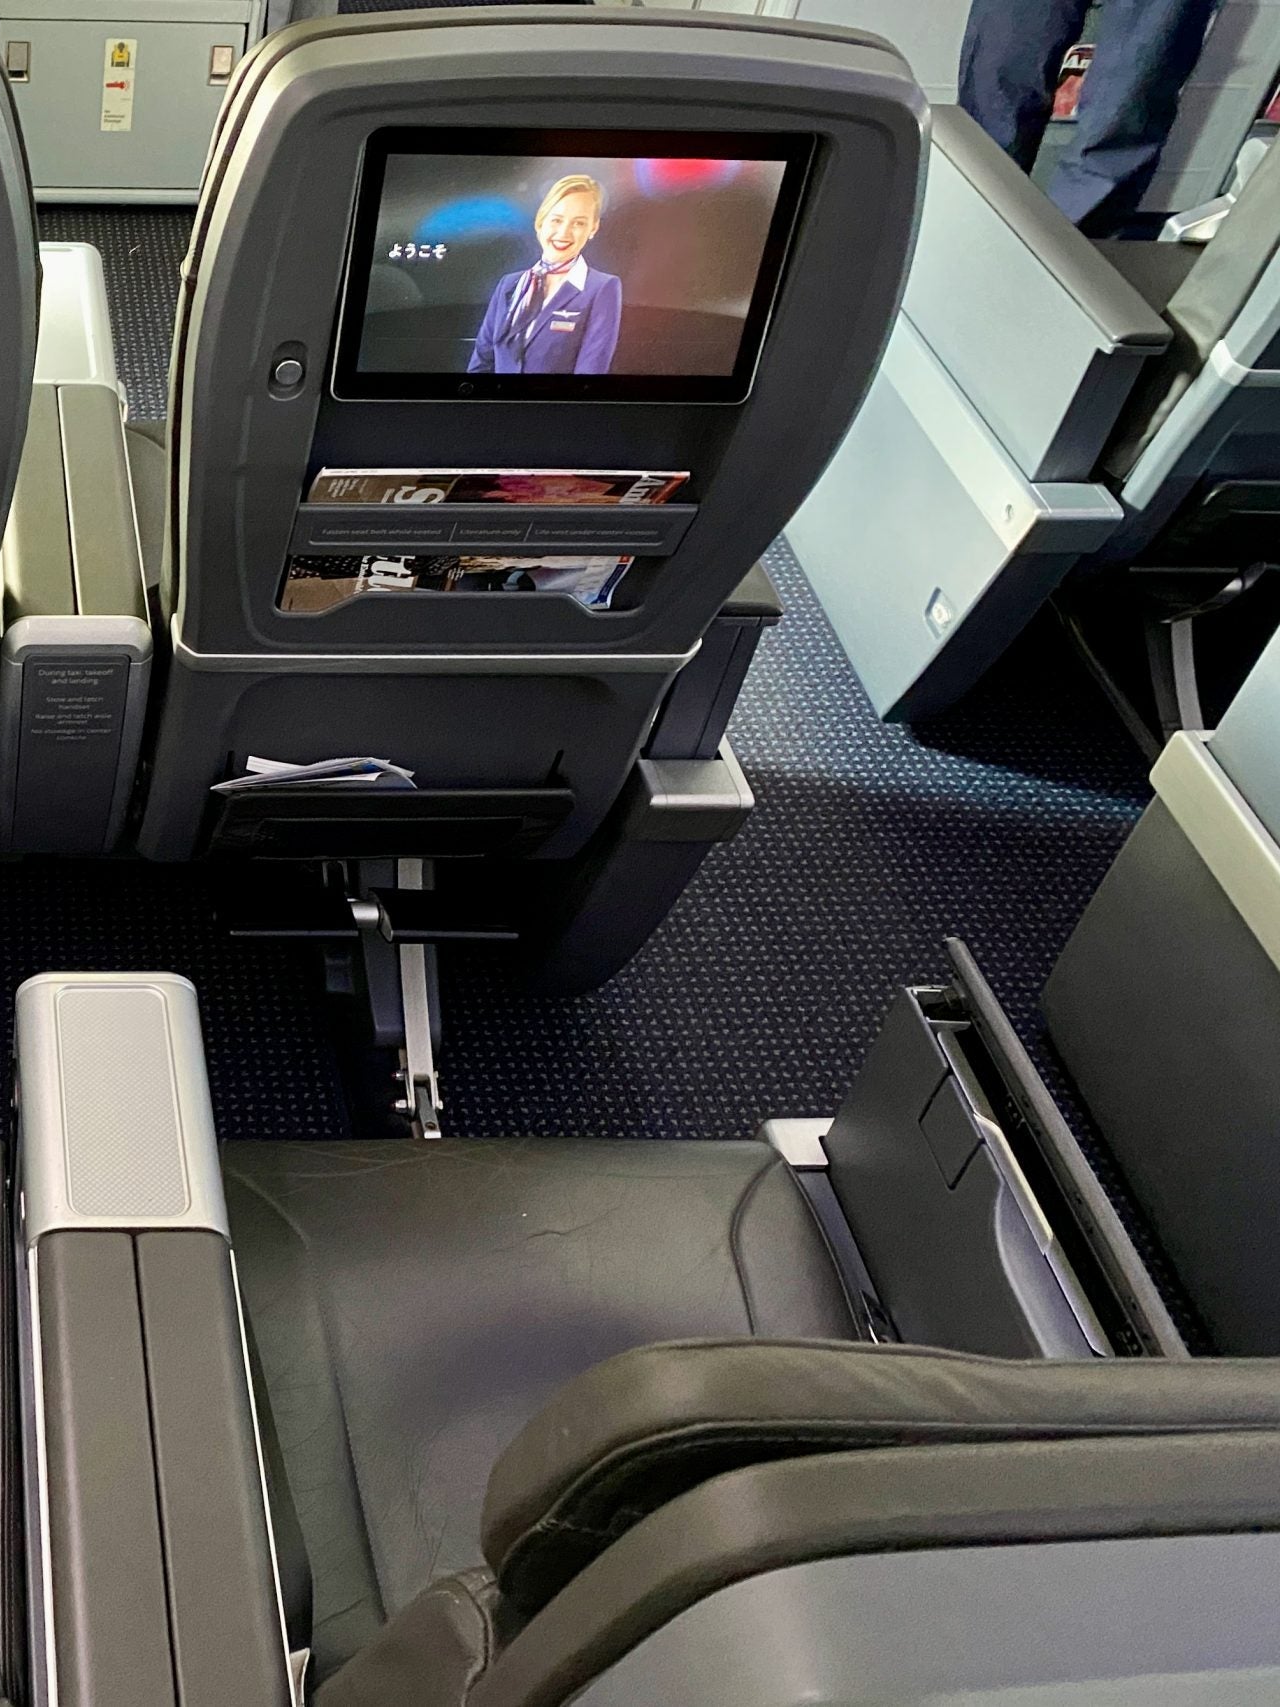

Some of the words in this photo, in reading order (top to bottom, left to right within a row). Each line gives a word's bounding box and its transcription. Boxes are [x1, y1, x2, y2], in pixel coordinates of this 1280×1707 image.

[388, 243, 447, 260] ようこそ
[38, 669, 66, 677] During
